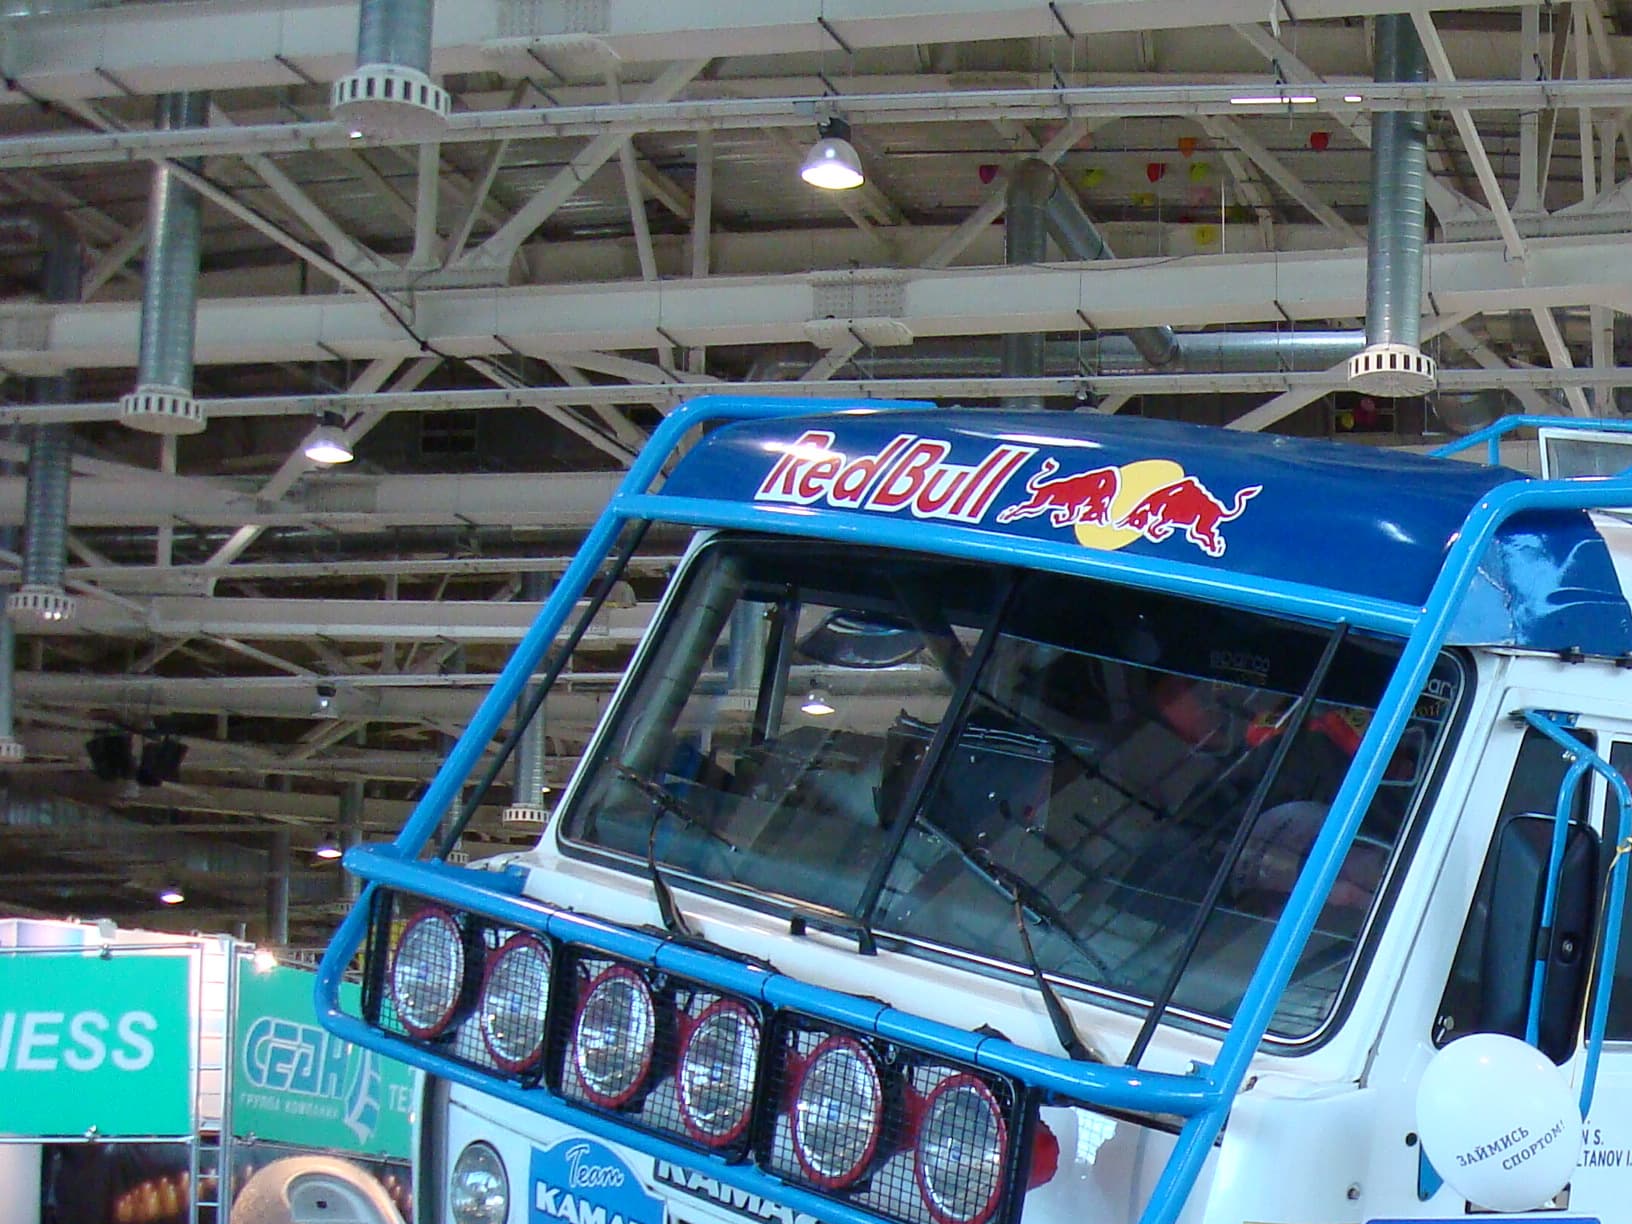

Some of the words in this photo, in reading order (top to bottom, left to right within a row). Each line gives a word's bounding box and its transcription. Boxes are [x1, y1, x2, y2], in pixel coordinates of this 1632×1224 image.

[0, 1010, 159, 1073] ESS
[564, 1143, 625, 1189] Team
[1454, 1125, 1530, 1169] ЗАЙМИСЬ
[1501, 1118, 1567, 1172] СПОРТОМ!
[1576, 1149, 1623, 1167] TANOV
